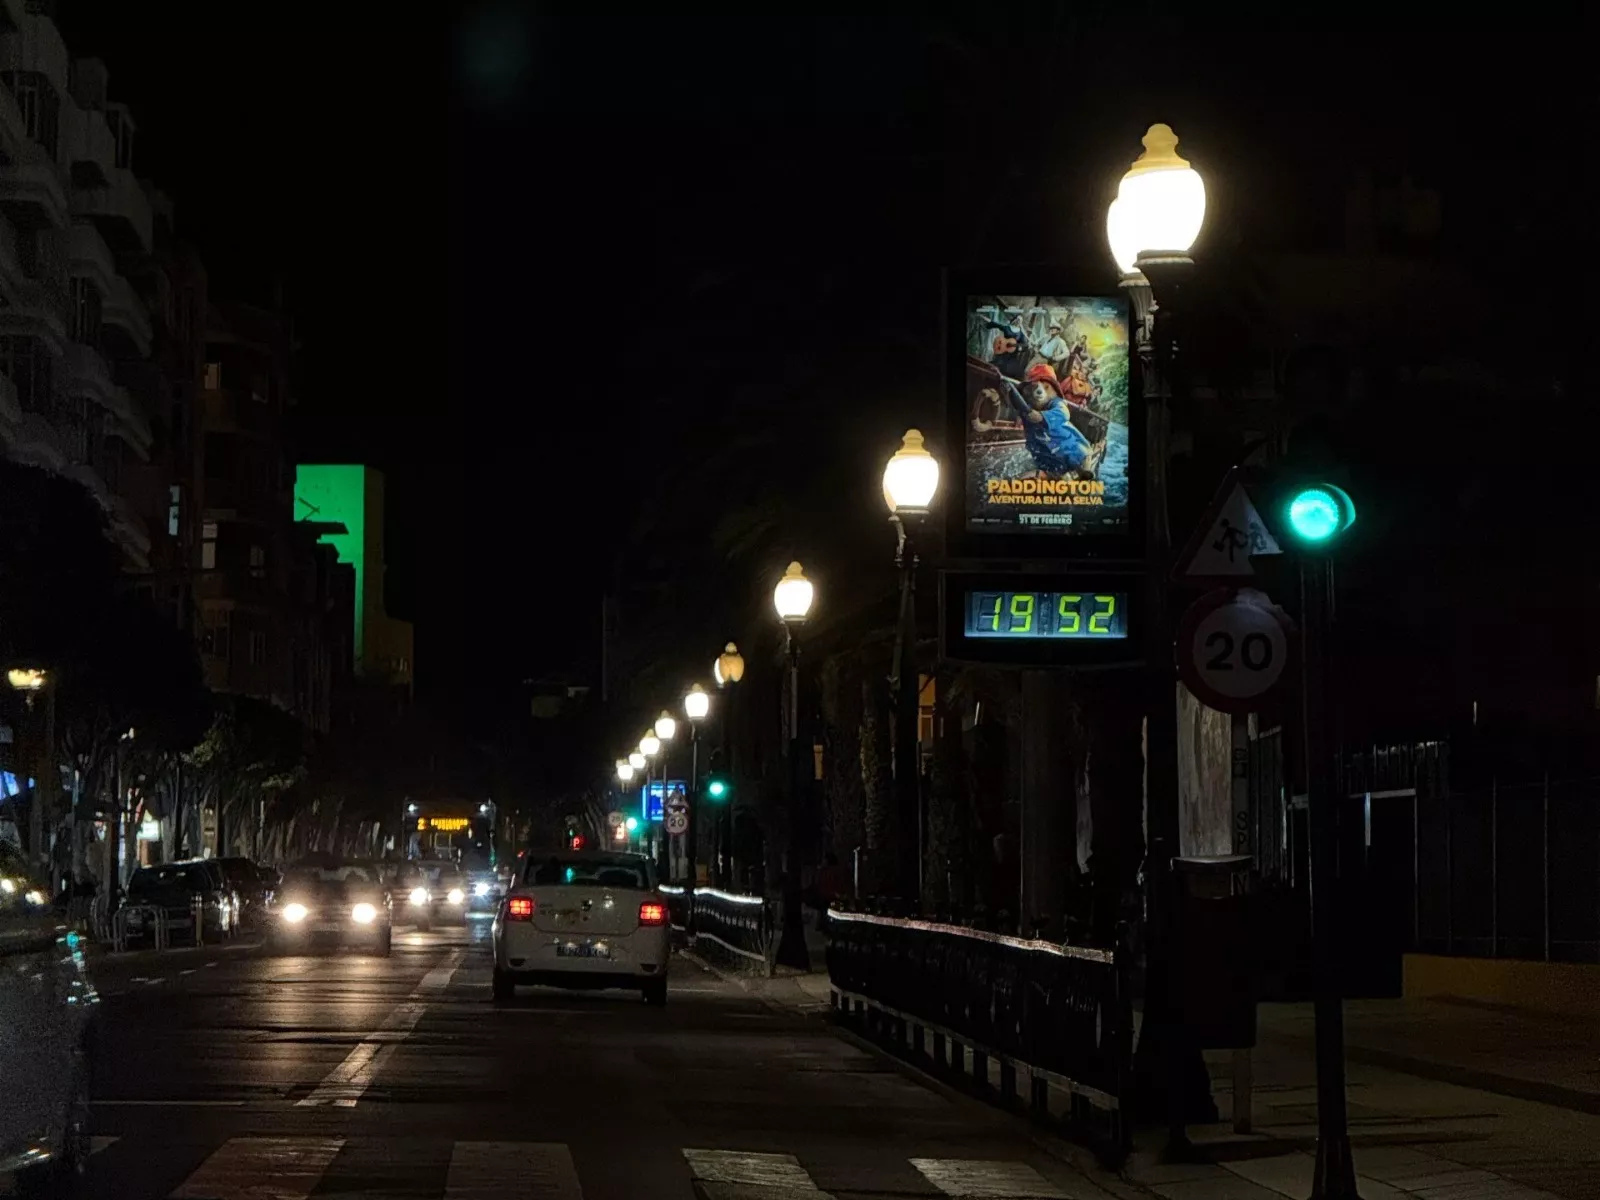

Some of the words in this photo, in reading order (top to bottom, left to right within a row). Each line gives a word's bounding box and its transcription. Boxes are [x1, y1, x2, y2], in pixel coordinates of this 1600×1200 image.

[988, 480, 1104, 495] PADDINGTON
[989, 495, 1041, 504] AVENTURA
[1043, 496, 1057, 504] EN
[1059, 496, 1071, 505] LA
[1073, 496, 1103, 505] SELVA
[992, 595, 1034, 633] 19
[1058, 596, 1116, 633] 52
[1205, 632, 1273, 671] 20
[670, 818, 685, 828] 20
